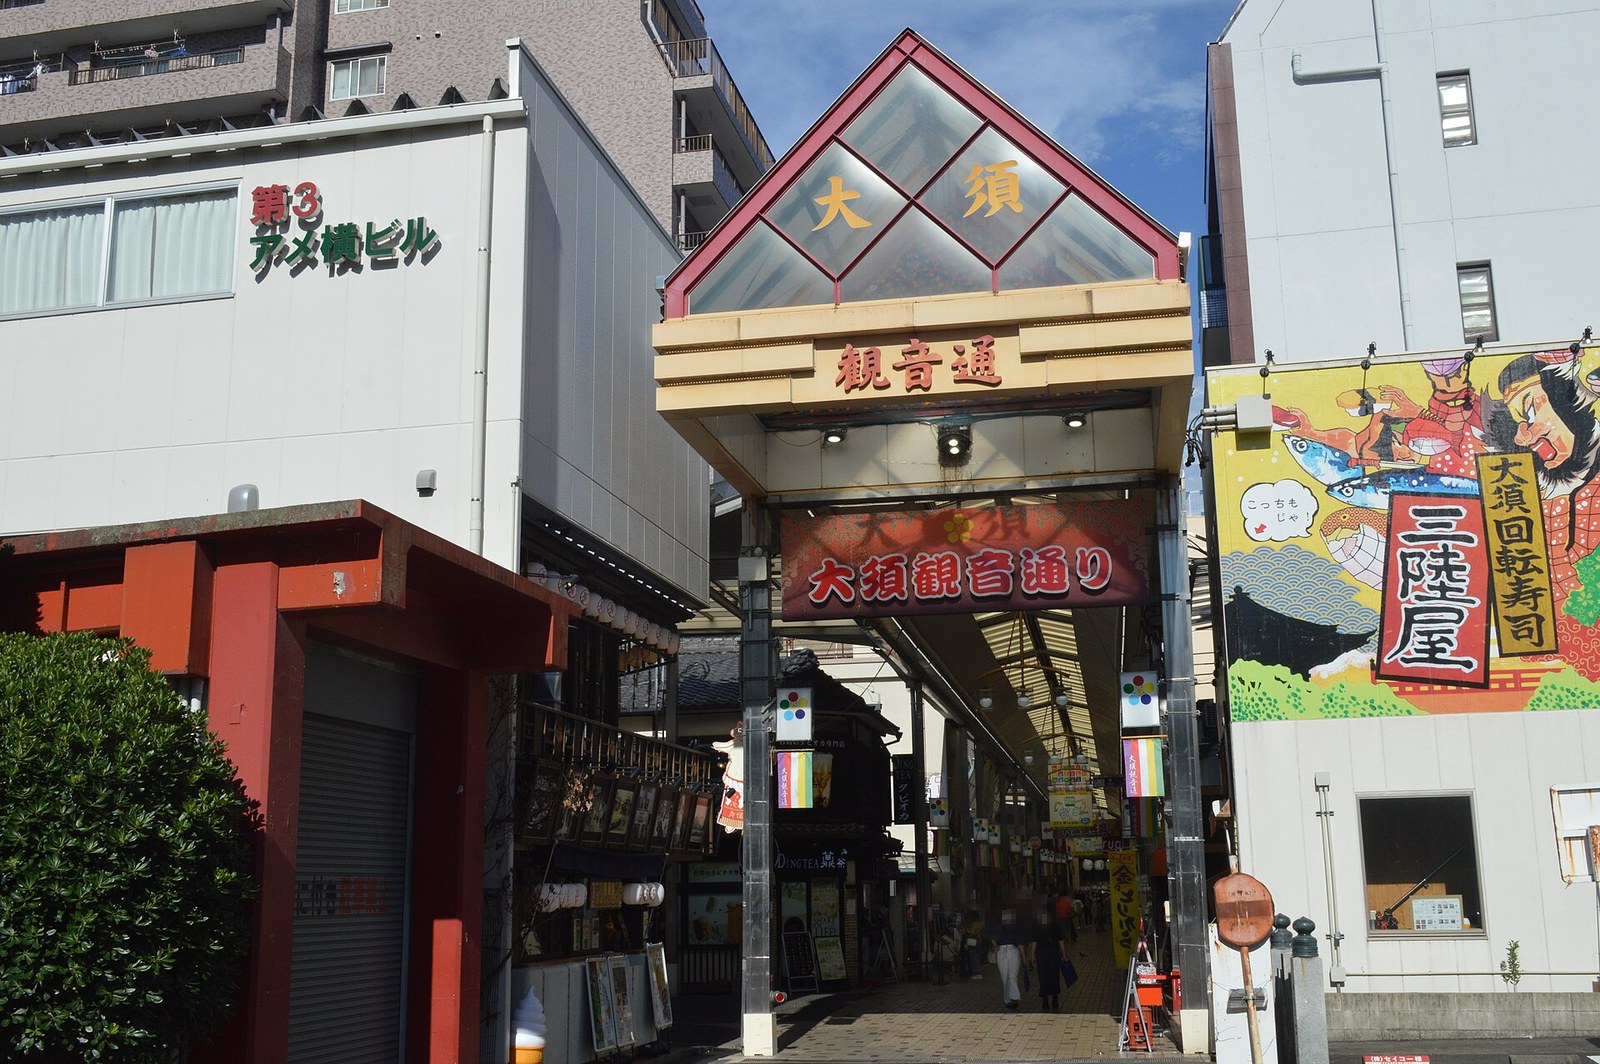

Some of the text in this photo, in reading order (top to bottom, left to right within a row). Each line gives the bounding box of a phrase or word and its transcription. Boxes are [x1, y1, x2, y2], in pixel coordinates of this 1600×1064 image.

[250, 181, 322, 226] 第3
[811, 159, 1025, 232] 大須
[249, 216, 439, 275] アメ横ビル
[836, 334, 1003, 394] 観音通
[1247, 497, 1299, 510] こっちも
[808, 545, 1114, 604] 大須観音通り
[1488, 457, 1548, 648] 大須回転寿司
[1384, 504, 1482, 674] 三陸屋
[898, 783, 910, 821] タピオカ
